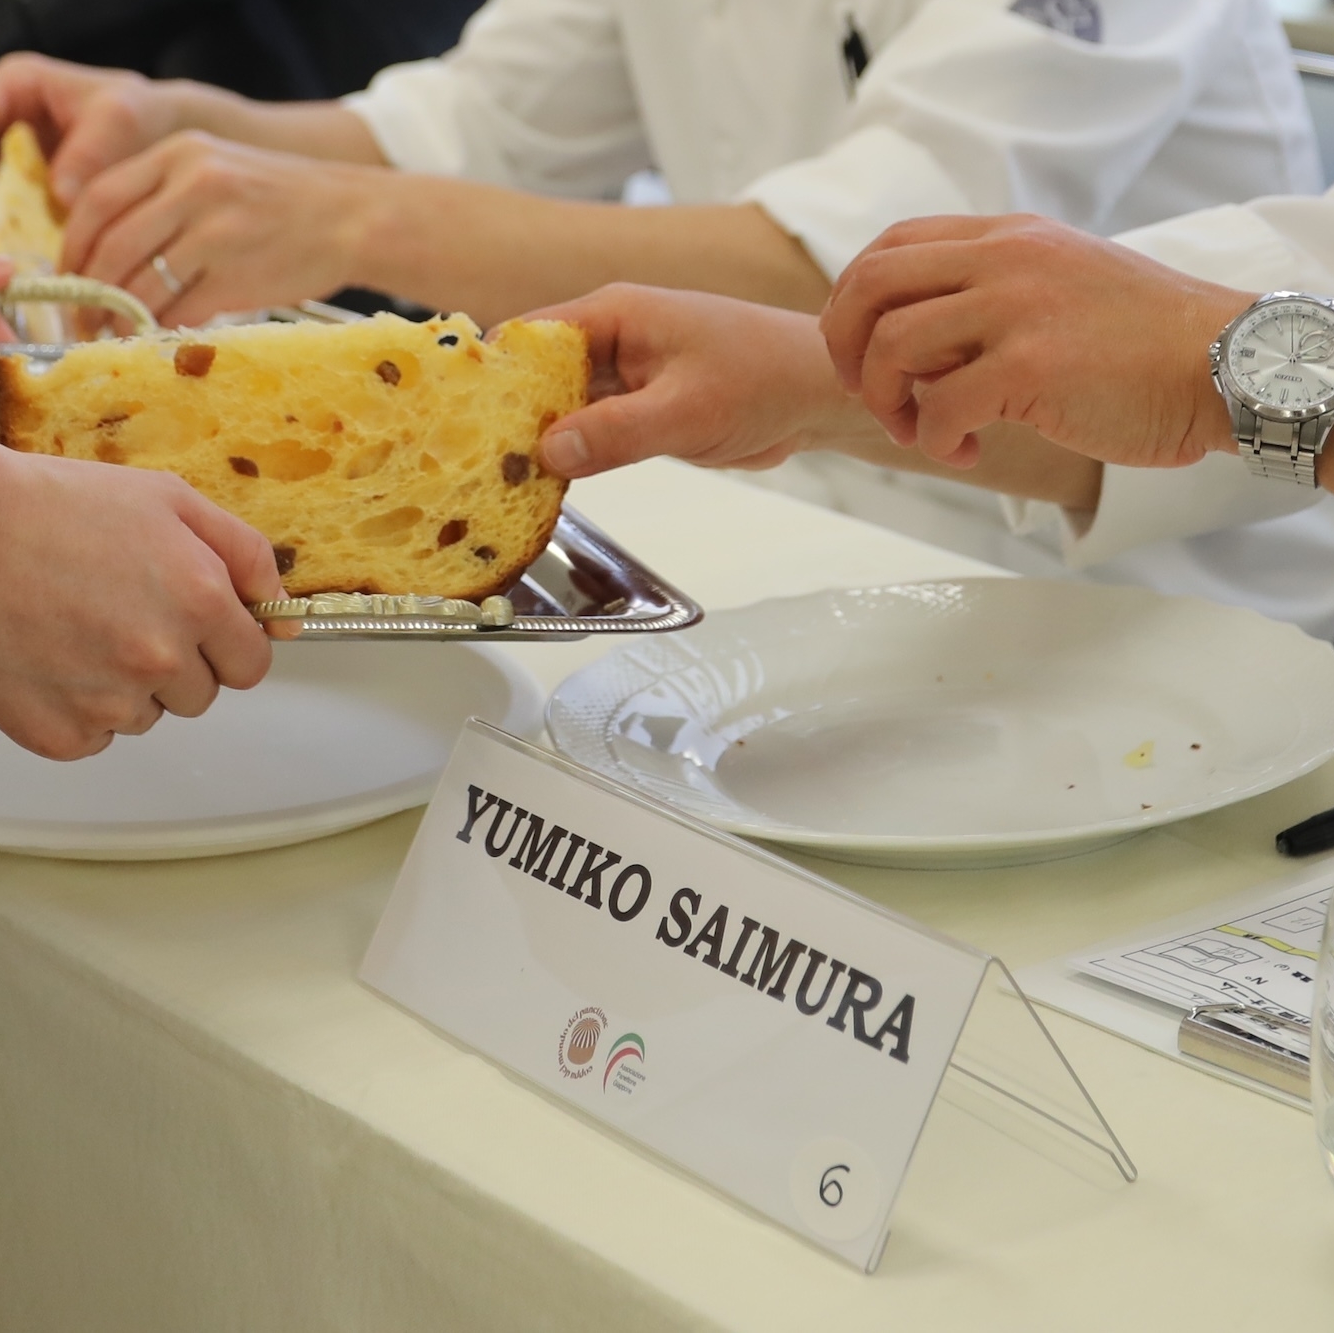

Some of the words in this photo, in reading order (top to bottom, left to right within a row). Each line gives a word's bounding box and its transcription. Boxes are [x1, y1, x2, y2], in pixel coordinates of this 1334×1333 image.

[455, 783, 652, 922] YUMIKO
[655, 886, 916, 1065] SAIMURA
[818, 1164, 850, 1207] 6
